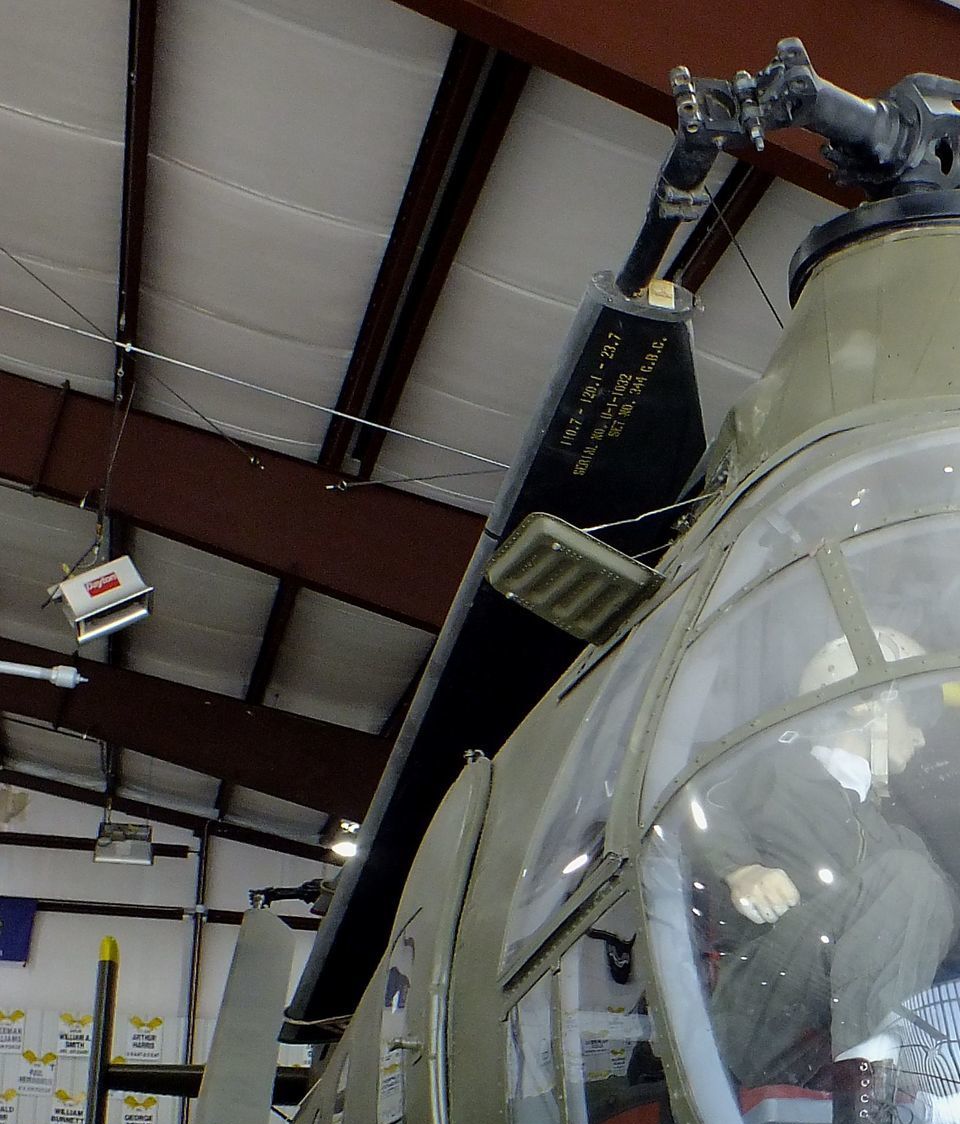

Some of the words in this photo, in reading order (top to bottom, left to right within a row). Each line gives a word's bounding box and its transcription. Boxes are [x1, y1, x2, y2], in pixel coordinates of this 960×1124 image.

[559, 417, 583, 446] 110.7
[601, 332, 622, 360] 23.7
[608, 420, 626, 438] SET
[630, 376, 648, 396] 344
[573, 444, 599, 476] SERIAL
